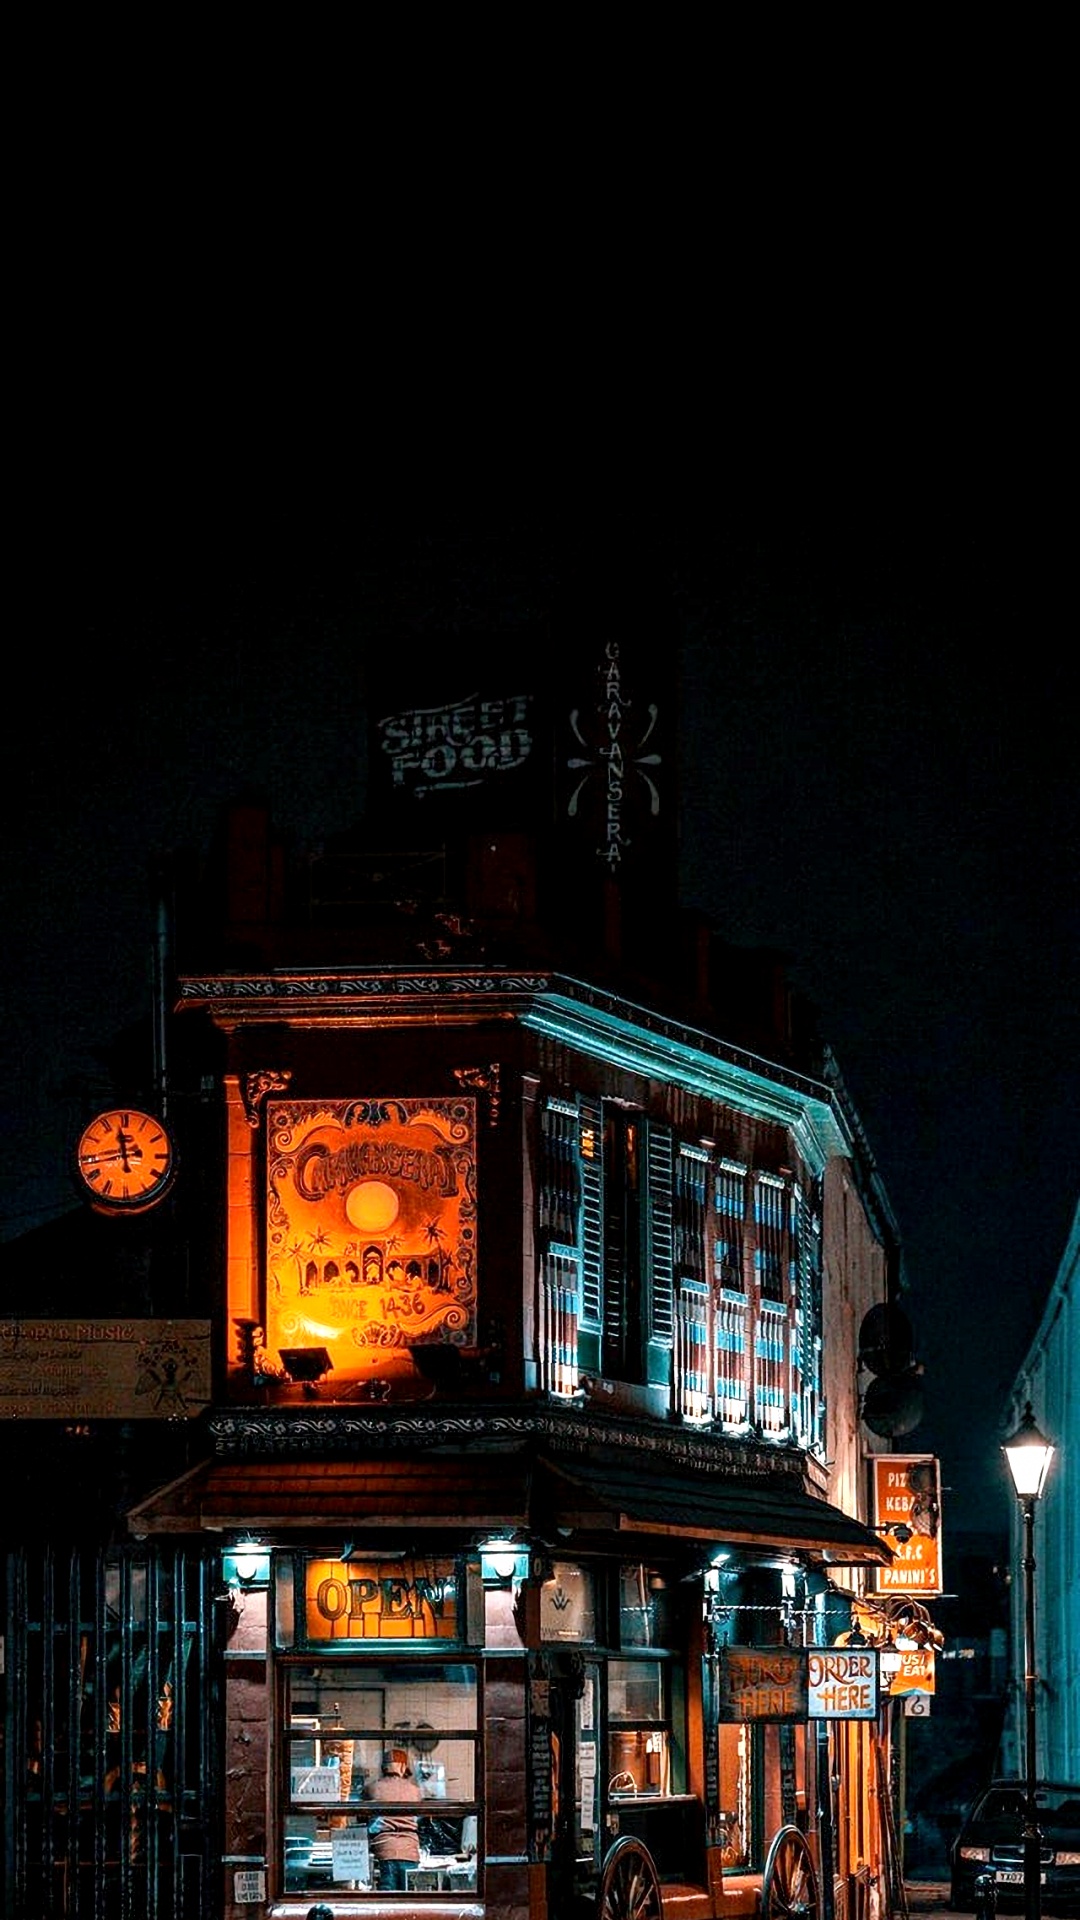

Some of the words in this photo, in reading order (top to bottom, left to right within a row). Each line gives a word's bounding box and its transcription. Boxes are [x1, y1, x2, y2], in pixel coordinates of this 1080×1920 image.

[379, 695, 534, 754] STREET
[391, 728, 533, 787] FOOD
[379, 1292, 426, 1320] 1436
[887, 1472, 908, 1488] PIZ
[883, 1567, 936, 1586] PANINI'S
[317, 1578, 455, 1621] OPEN
[808, 1654, 874, 1688] ORDER
[903, 1665, 926, 1677] EAT
[817, 1684, 872, 1712] HERE
